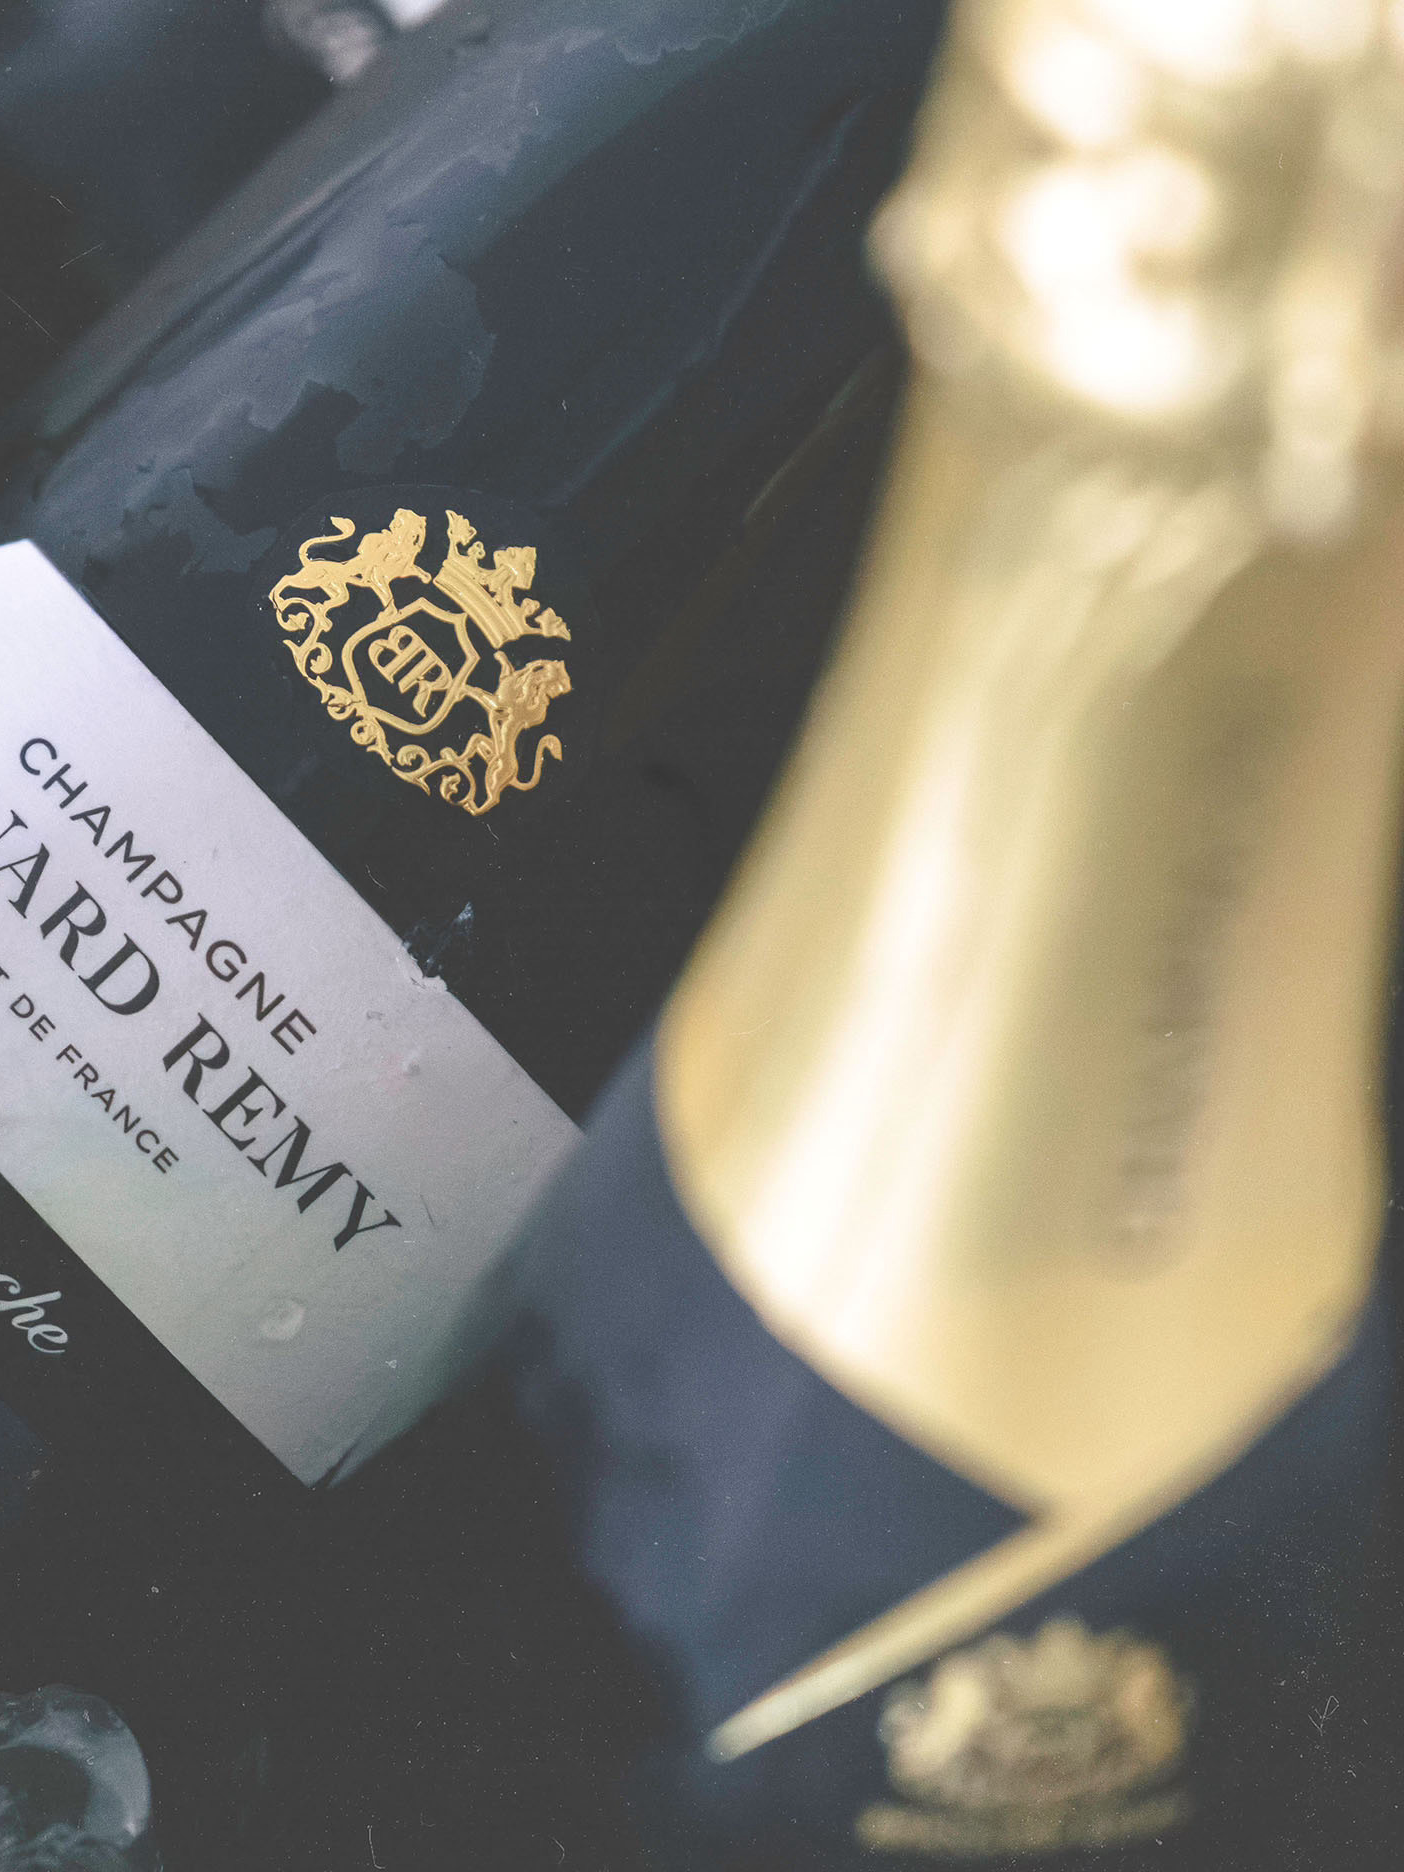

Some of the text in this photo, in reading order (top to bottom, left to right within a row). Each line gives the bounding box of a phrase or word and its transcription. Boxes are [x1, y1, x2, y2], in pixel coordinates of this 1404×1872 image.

[18, 736, 319, 1057] CHAMPAGNE
[8, 993, 57, 1043] DE
[55, 1043, 180, 1175] FRANCE
[161, 1011, 403, 1254] REMY
